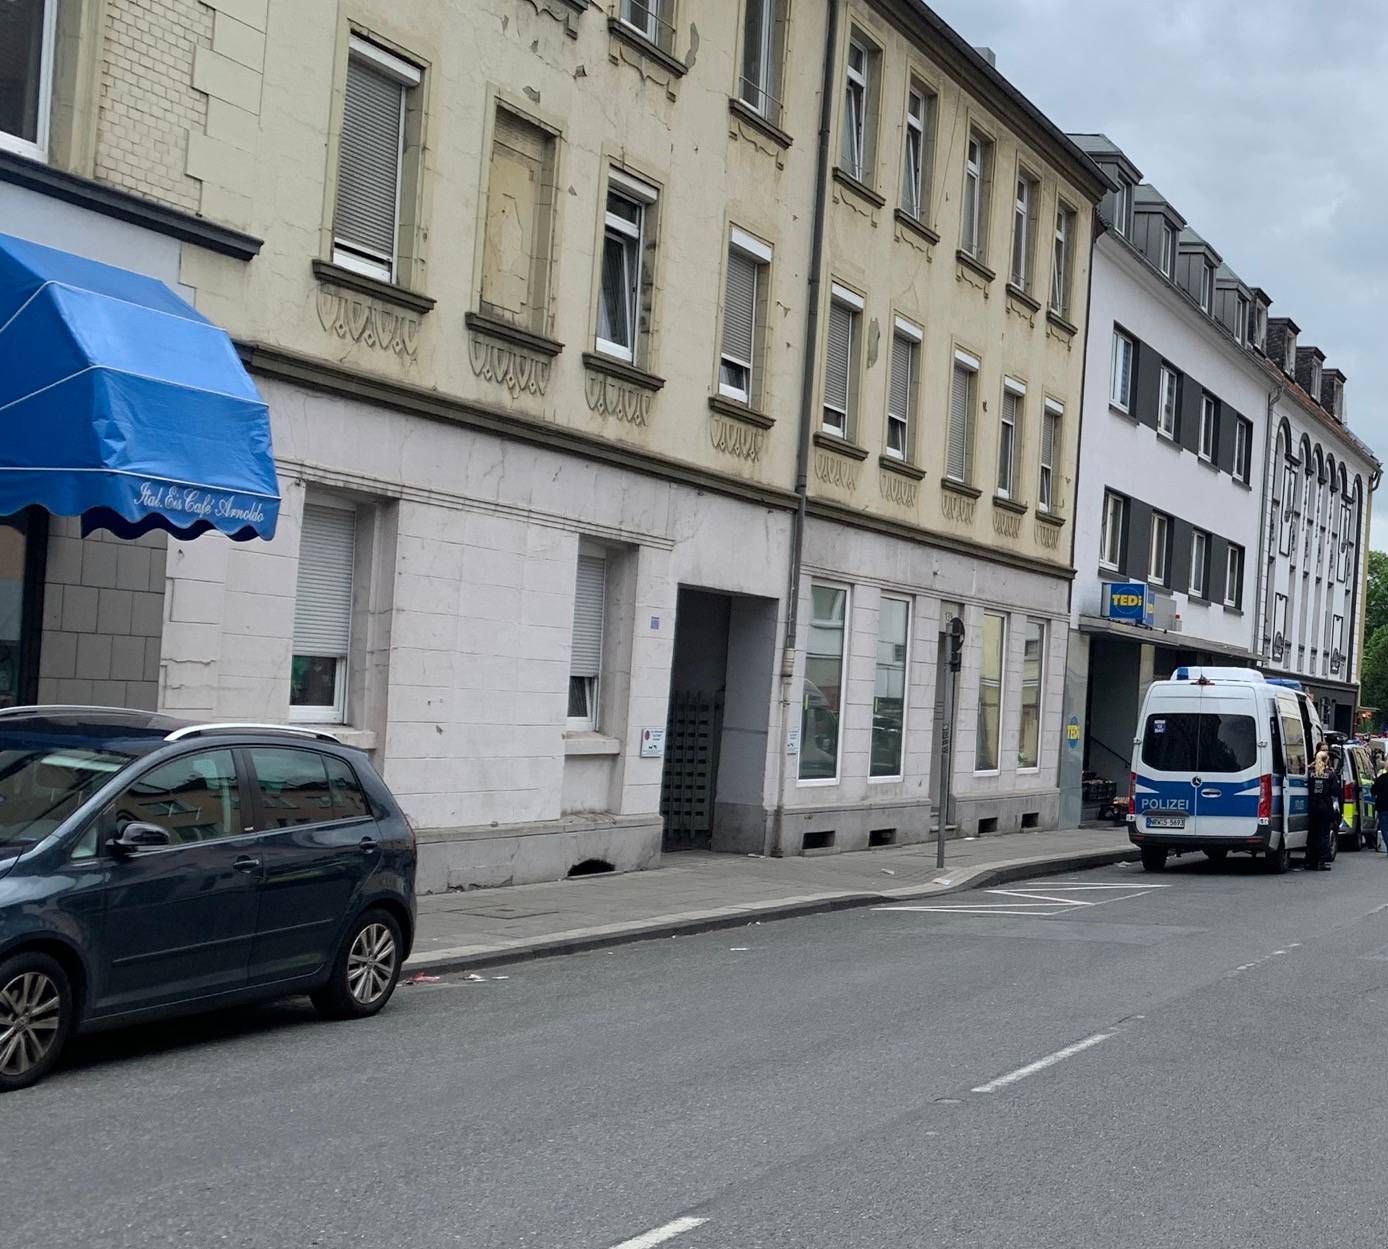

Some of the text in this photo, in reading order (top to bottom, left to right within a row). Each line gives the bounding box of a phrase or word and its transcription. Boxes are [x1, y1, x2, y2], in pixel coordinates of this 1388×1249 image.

[134, 482, 264, 522] Ital. Eis Café Arnoldo
[1111, 594, 1142, 606] TEDi
[1141, 798, 1189, 810] POLIZEI
